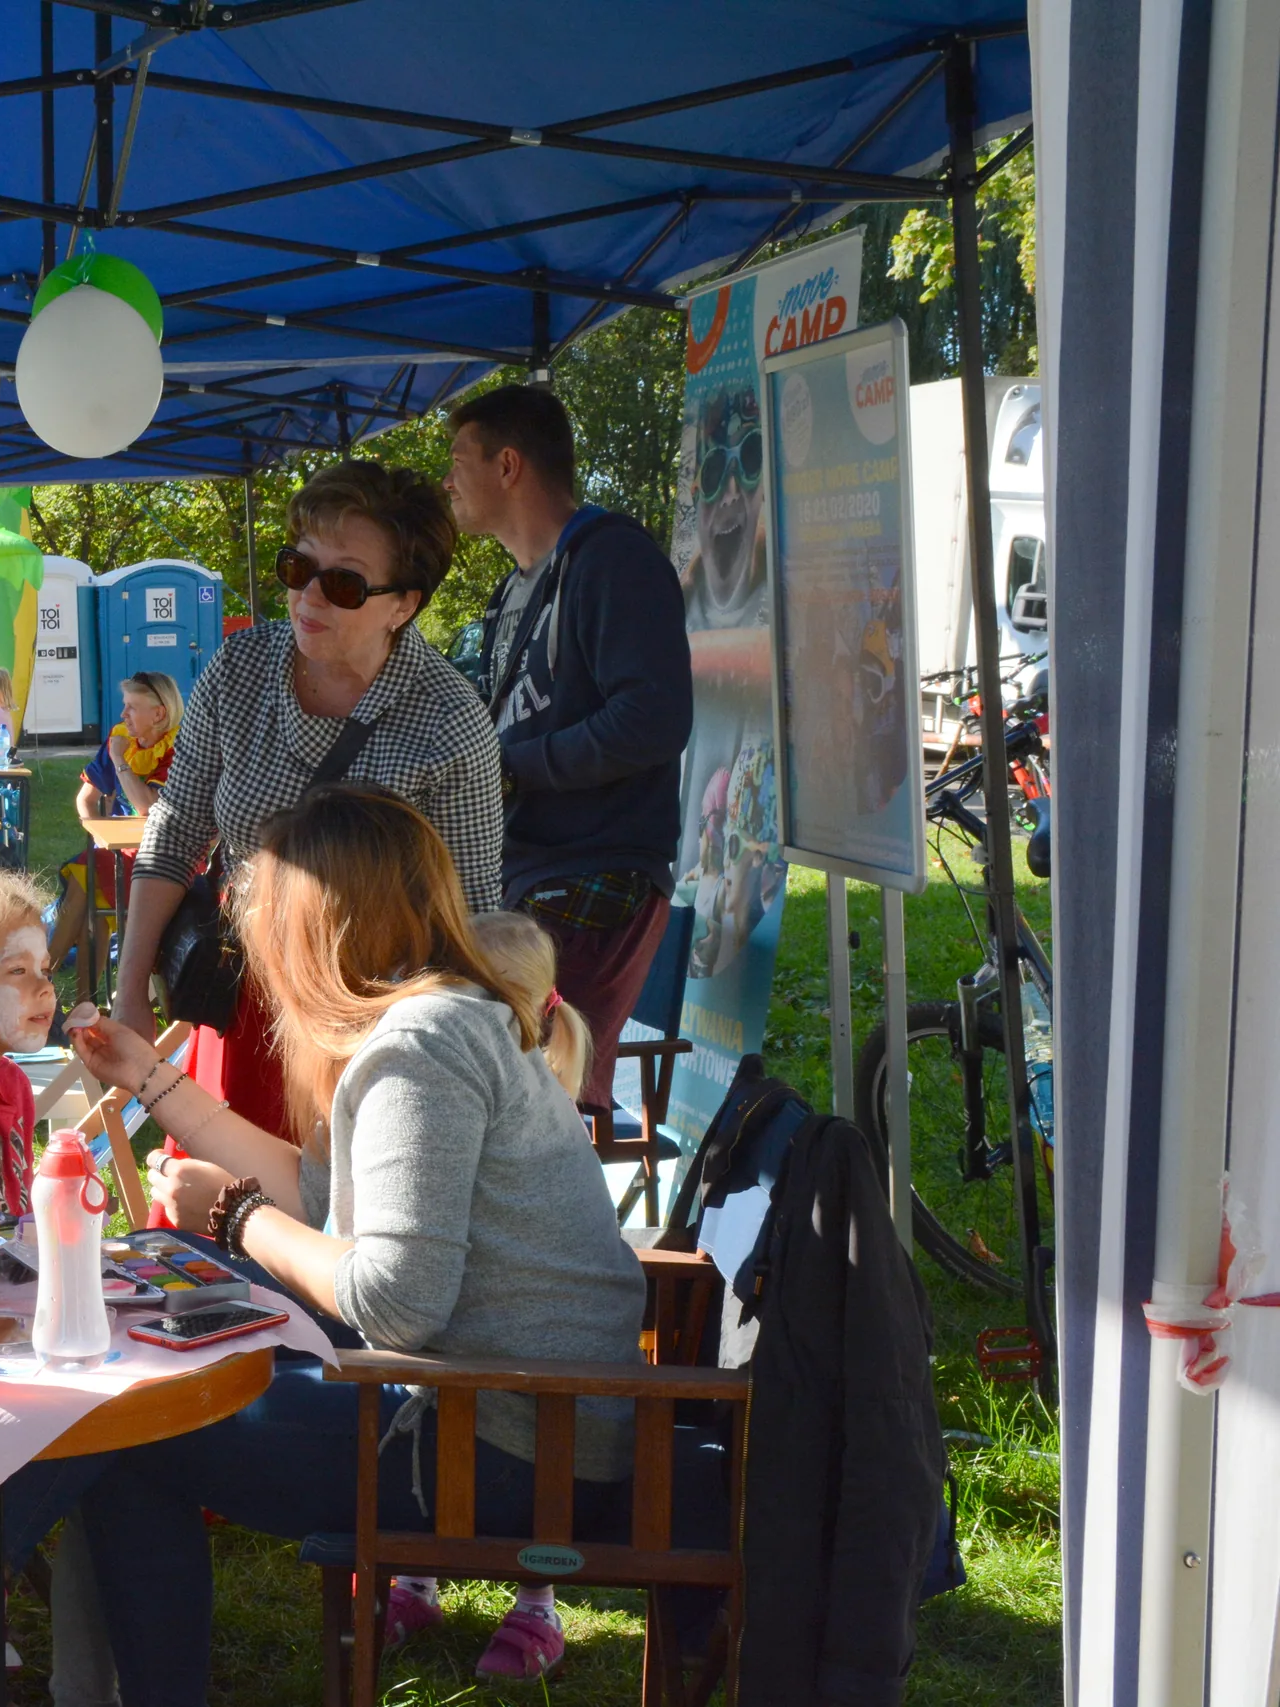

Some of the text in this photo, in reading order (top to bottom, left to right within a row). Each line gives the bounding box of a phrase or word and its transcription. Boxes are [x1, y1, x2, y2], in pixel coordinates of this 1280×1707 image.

[779, 266, 834, 320] move
[764, 296, 847, 356] CAMP
[855, 377, 896, 409] CAMP
[40, 605, 60, 619] TOI
[153, 595, 172, 608] TOI
[153, 608, 172, 618] TOI
[40, 619, 60, 629] TOI
[680, 1043, 739, 1089] ORTOWE
